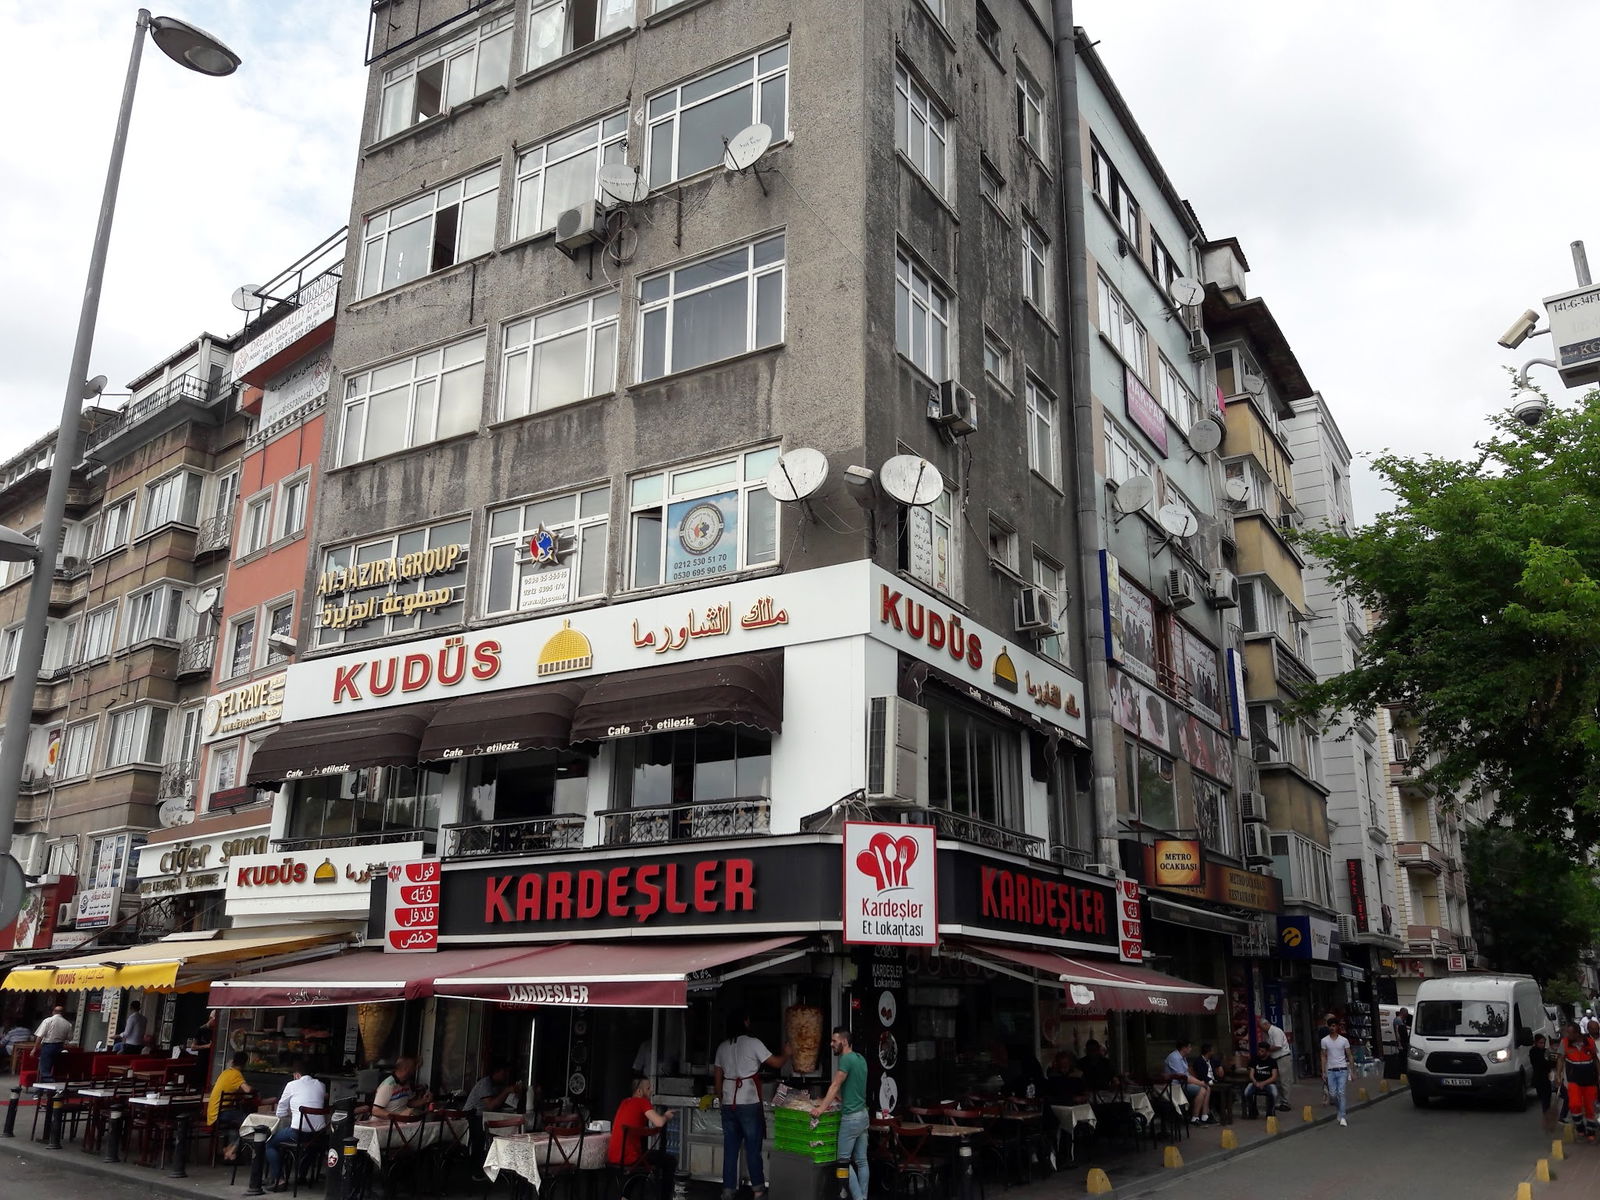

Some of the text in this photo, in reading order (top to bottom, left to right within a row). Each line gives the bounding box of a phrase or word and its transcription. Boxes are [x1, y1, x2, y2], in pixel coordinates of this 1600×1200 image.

[401, 544, 460, 579] GROUP
[674, 553, 727, 570] 0212 530 51 70
[673, 564, 727, 580] 0530 695 90 05
[632, 596, 790, 655] ملك الشاورما
[880, 583, 983, 670] KUDÜS
[332, 635, 502, 704] KUDÜS
[608, 716, 695, 736] Cafe etileziz
[443, 741, 520, 758] Cafe etileziz
[286, 763, 351, 779] Cafe etileziz
[1160, 862, 1198, 872] OCAKBAŞI
[1165, 853, 1192, 861] METRO
[237, 857, 308, 888] KUDÜS
[415, 863, 434, 881] فول
[484, 858, 754, 922] KARDEŞLER
[981, 865, 1107, 935] KARDEŞLER
[404, 907, 434, 927] فلافل
[862, 897, 924, 921] Kardeşler
[862, 920, 924, 937] Et Lokantası
[1452, 958, 1462, 968] E
[56, 970, 76, 985] KUDÜS
[508, 984, 589, 1004] KARDEŞLER
